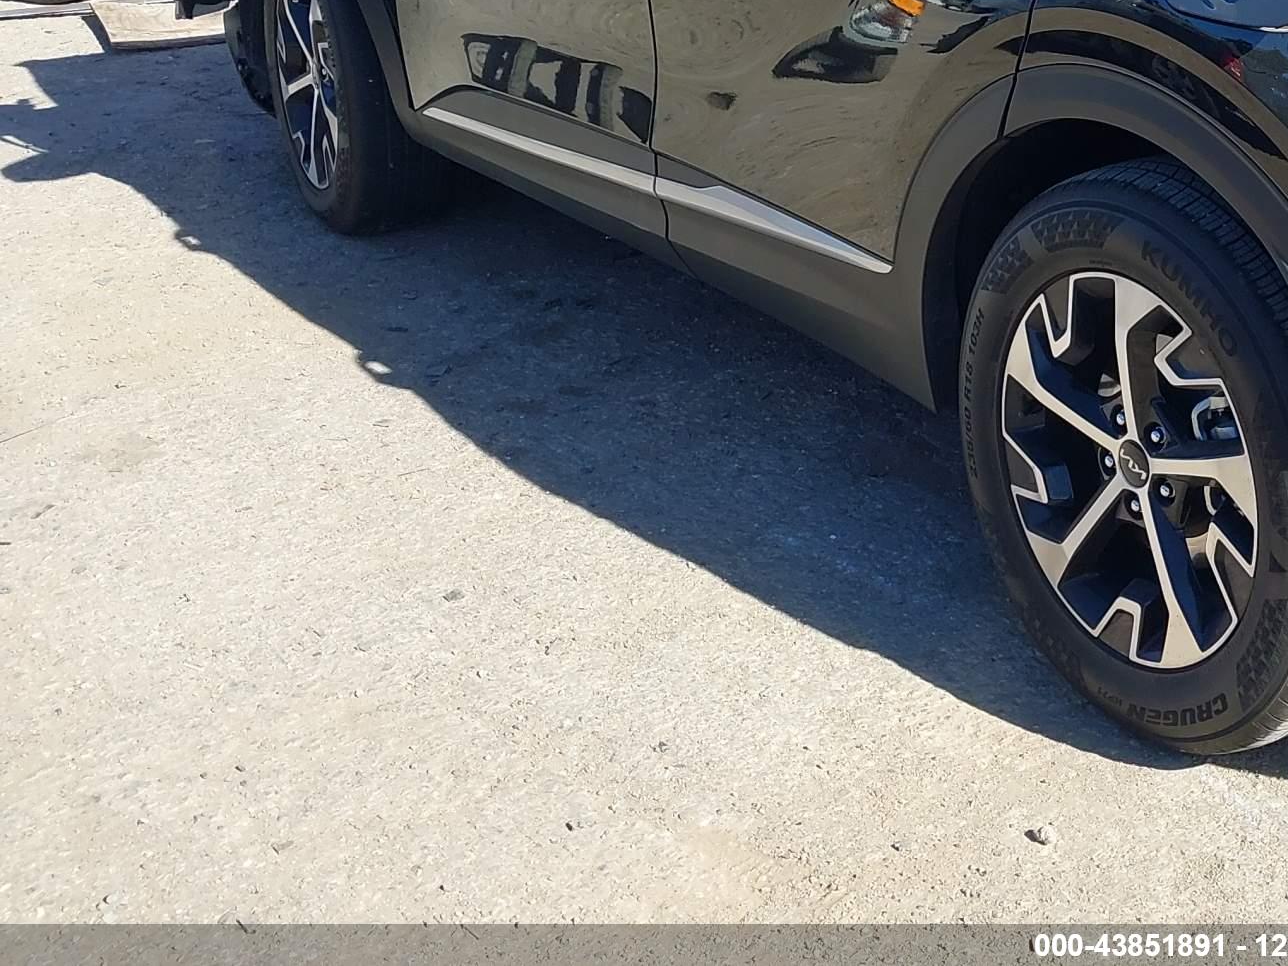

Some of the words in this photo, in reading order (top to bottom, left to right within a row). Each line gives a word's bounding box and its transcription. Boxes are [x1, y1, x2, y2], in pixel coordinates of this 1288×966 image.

[1141, 240, 1238, 357] KUMHO
[963, 361, 975, 402] R18
[1126, 692, 1230, 727] CRUGEN
